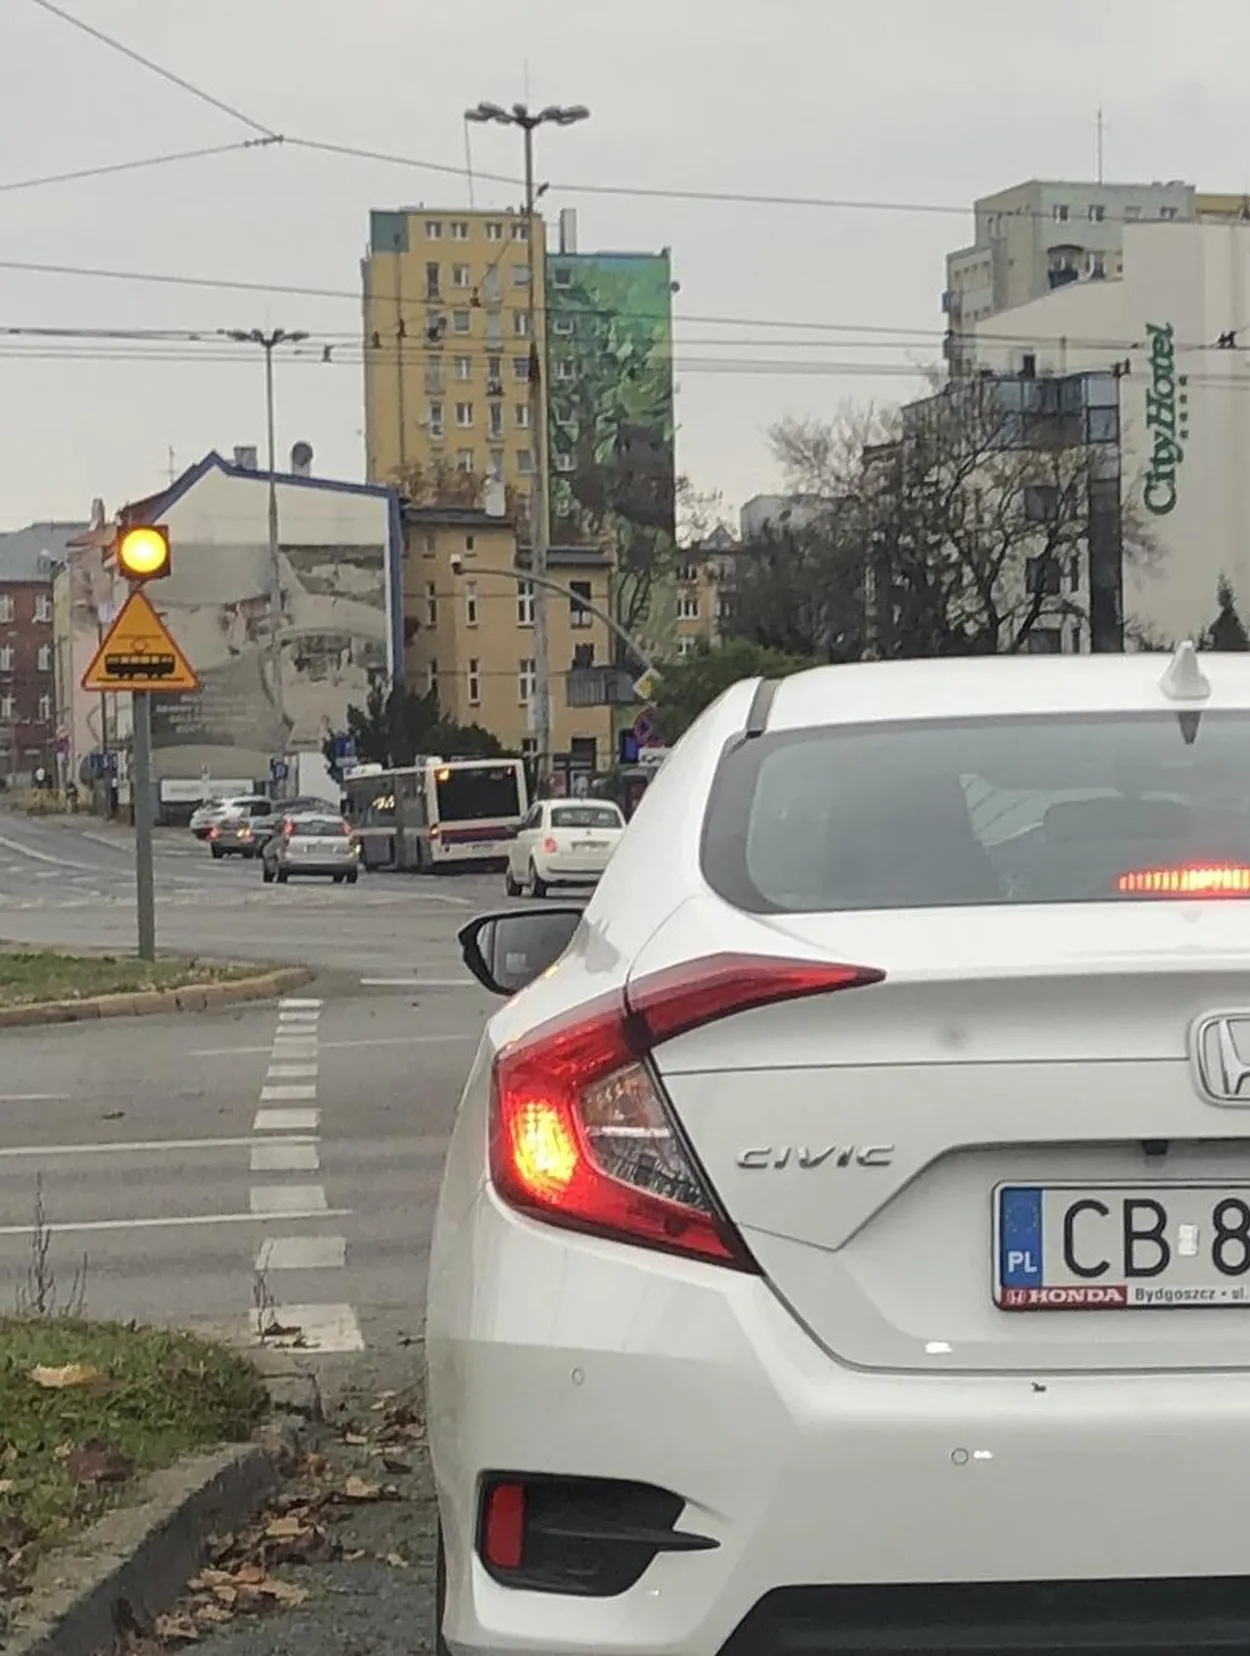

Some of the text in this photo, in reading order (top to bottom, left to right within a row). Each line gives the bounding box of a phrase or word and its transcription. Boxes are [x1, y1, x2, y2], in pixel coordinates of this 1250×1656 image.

[736, 1145, 895, 1170] CIVIC
[1063, 1198, 1171, 1279] CB
[1007, 1251, 1038, 1274] PL
[1029, 1287, 1124, 1304] HONDA
[1135, 1286, 1215, 1302] Bydgoszcz
